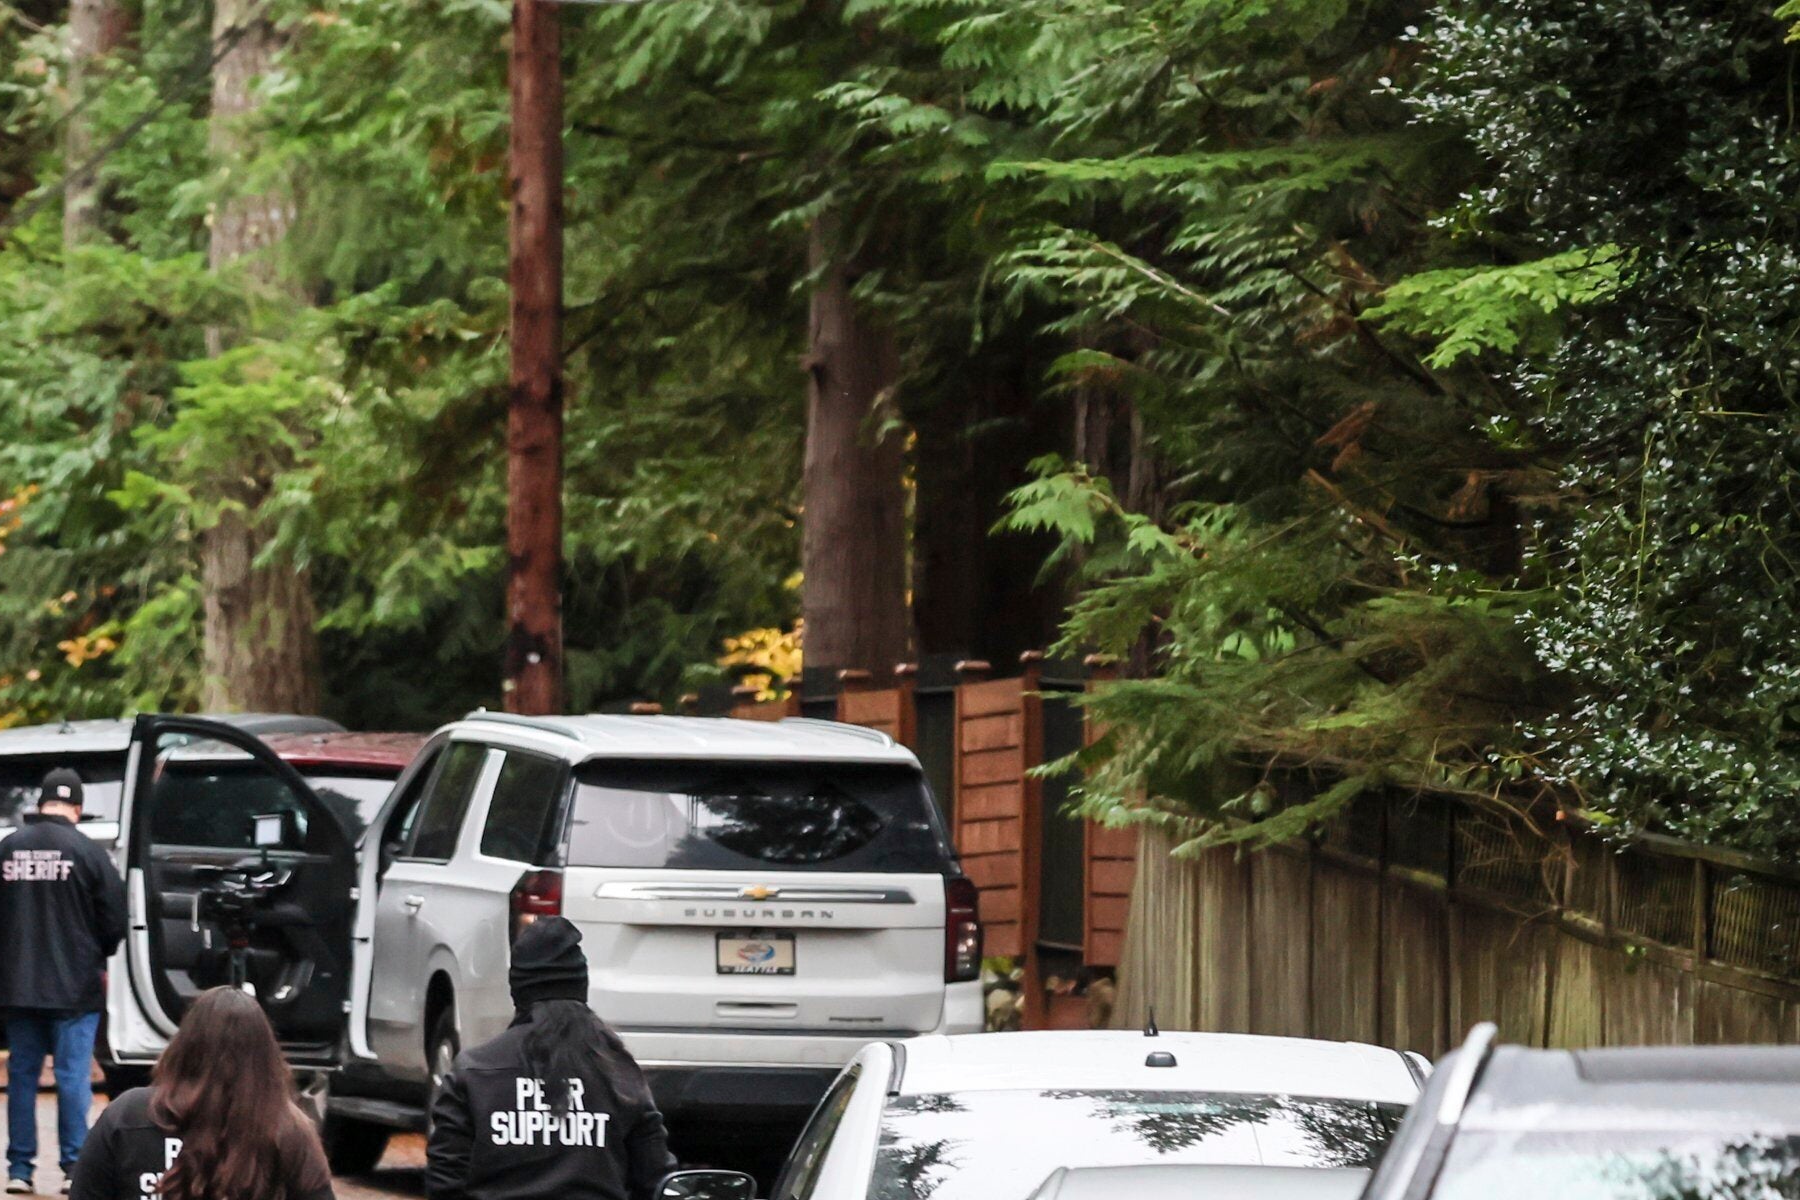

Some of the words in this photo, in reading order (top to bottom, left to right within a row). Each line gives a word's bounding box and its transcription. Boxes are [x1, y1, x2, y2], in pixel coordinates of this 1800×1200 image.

[2, 860, 74, 881] SHERIFF
[684, 908, 834, 919] SUBURBAN
[516, 1077, 585, 1111] PER
[490, 1111, 610, 1147] SUPPORT
